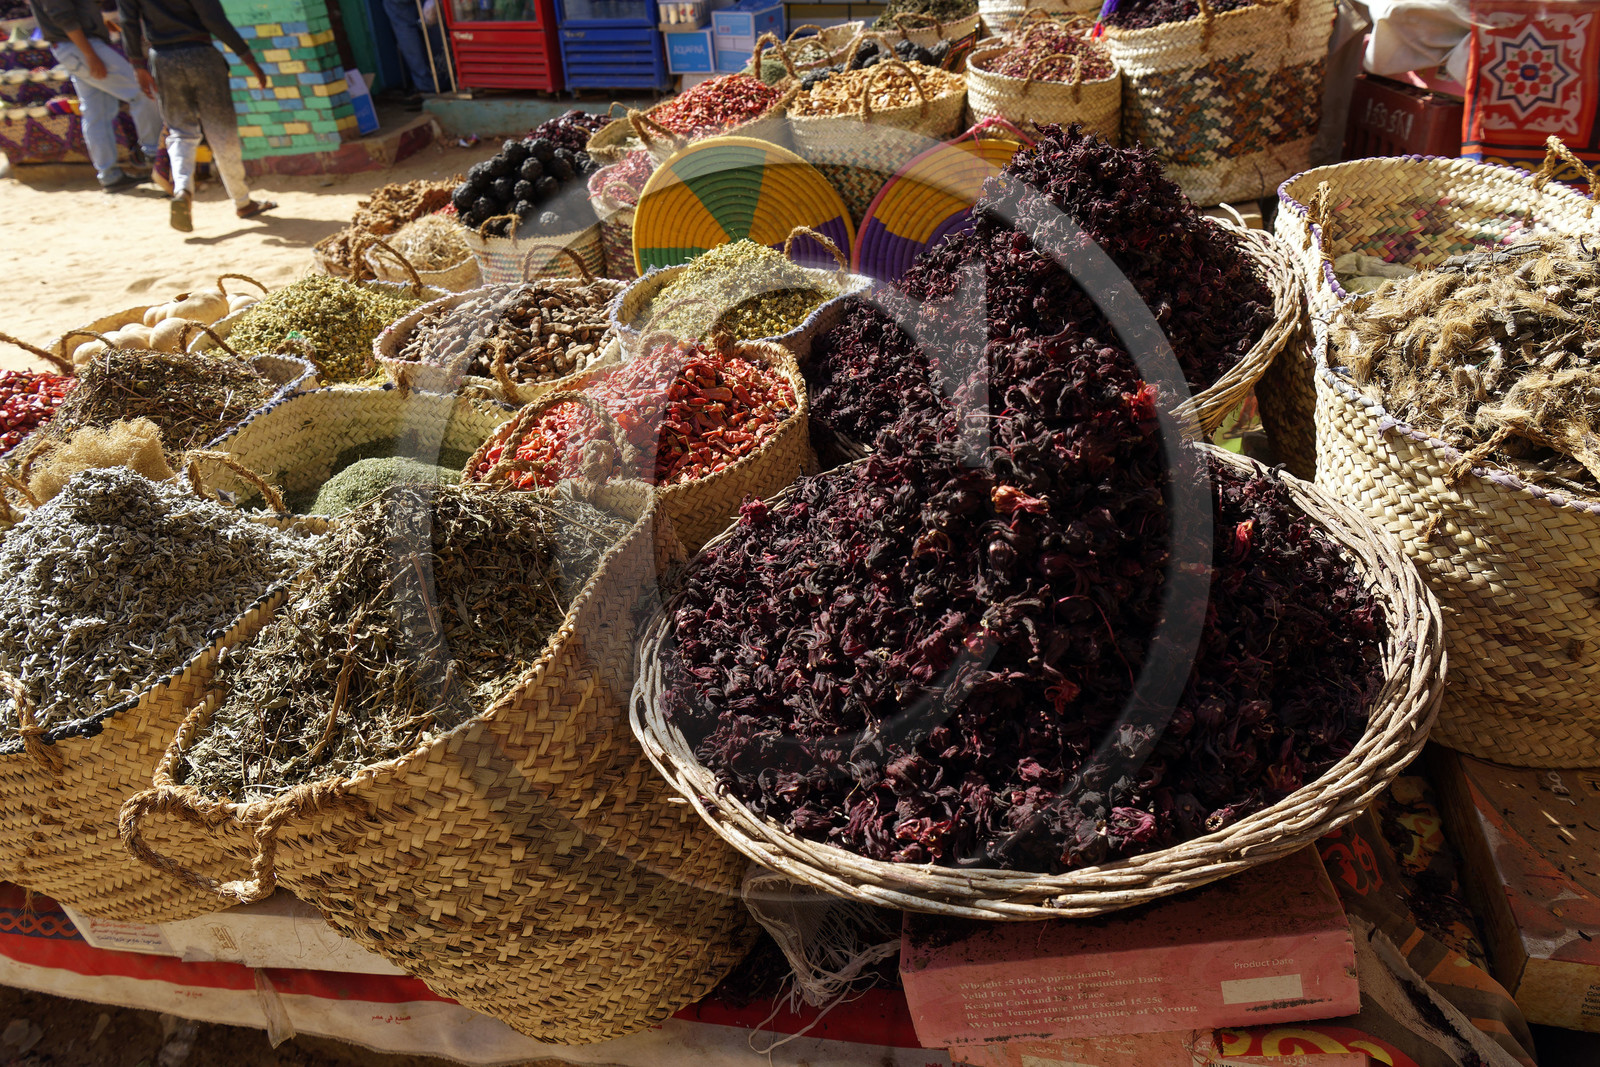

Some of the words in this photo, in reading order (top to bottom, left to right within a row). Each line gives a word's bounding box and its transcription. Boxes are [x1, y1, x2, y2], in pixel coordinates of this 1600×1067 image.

[1234, 960, 1269, 969] Product
[1019, 987, 1043, 995] Year
[1046, 985, 1074, 993] From
[1077, 978, 1135, 989] Production
[1138, 976, 1163, 984] Date
[1006, 1006, 1068, 1016] Temperature
[1092, 999, 1126, 1008] Exceed
[1033, 996, 1051, 1004] and
[1043, 1009, 1132, 1022] Responsibility
[1153, 1005, 1198, 1013] Wrong
